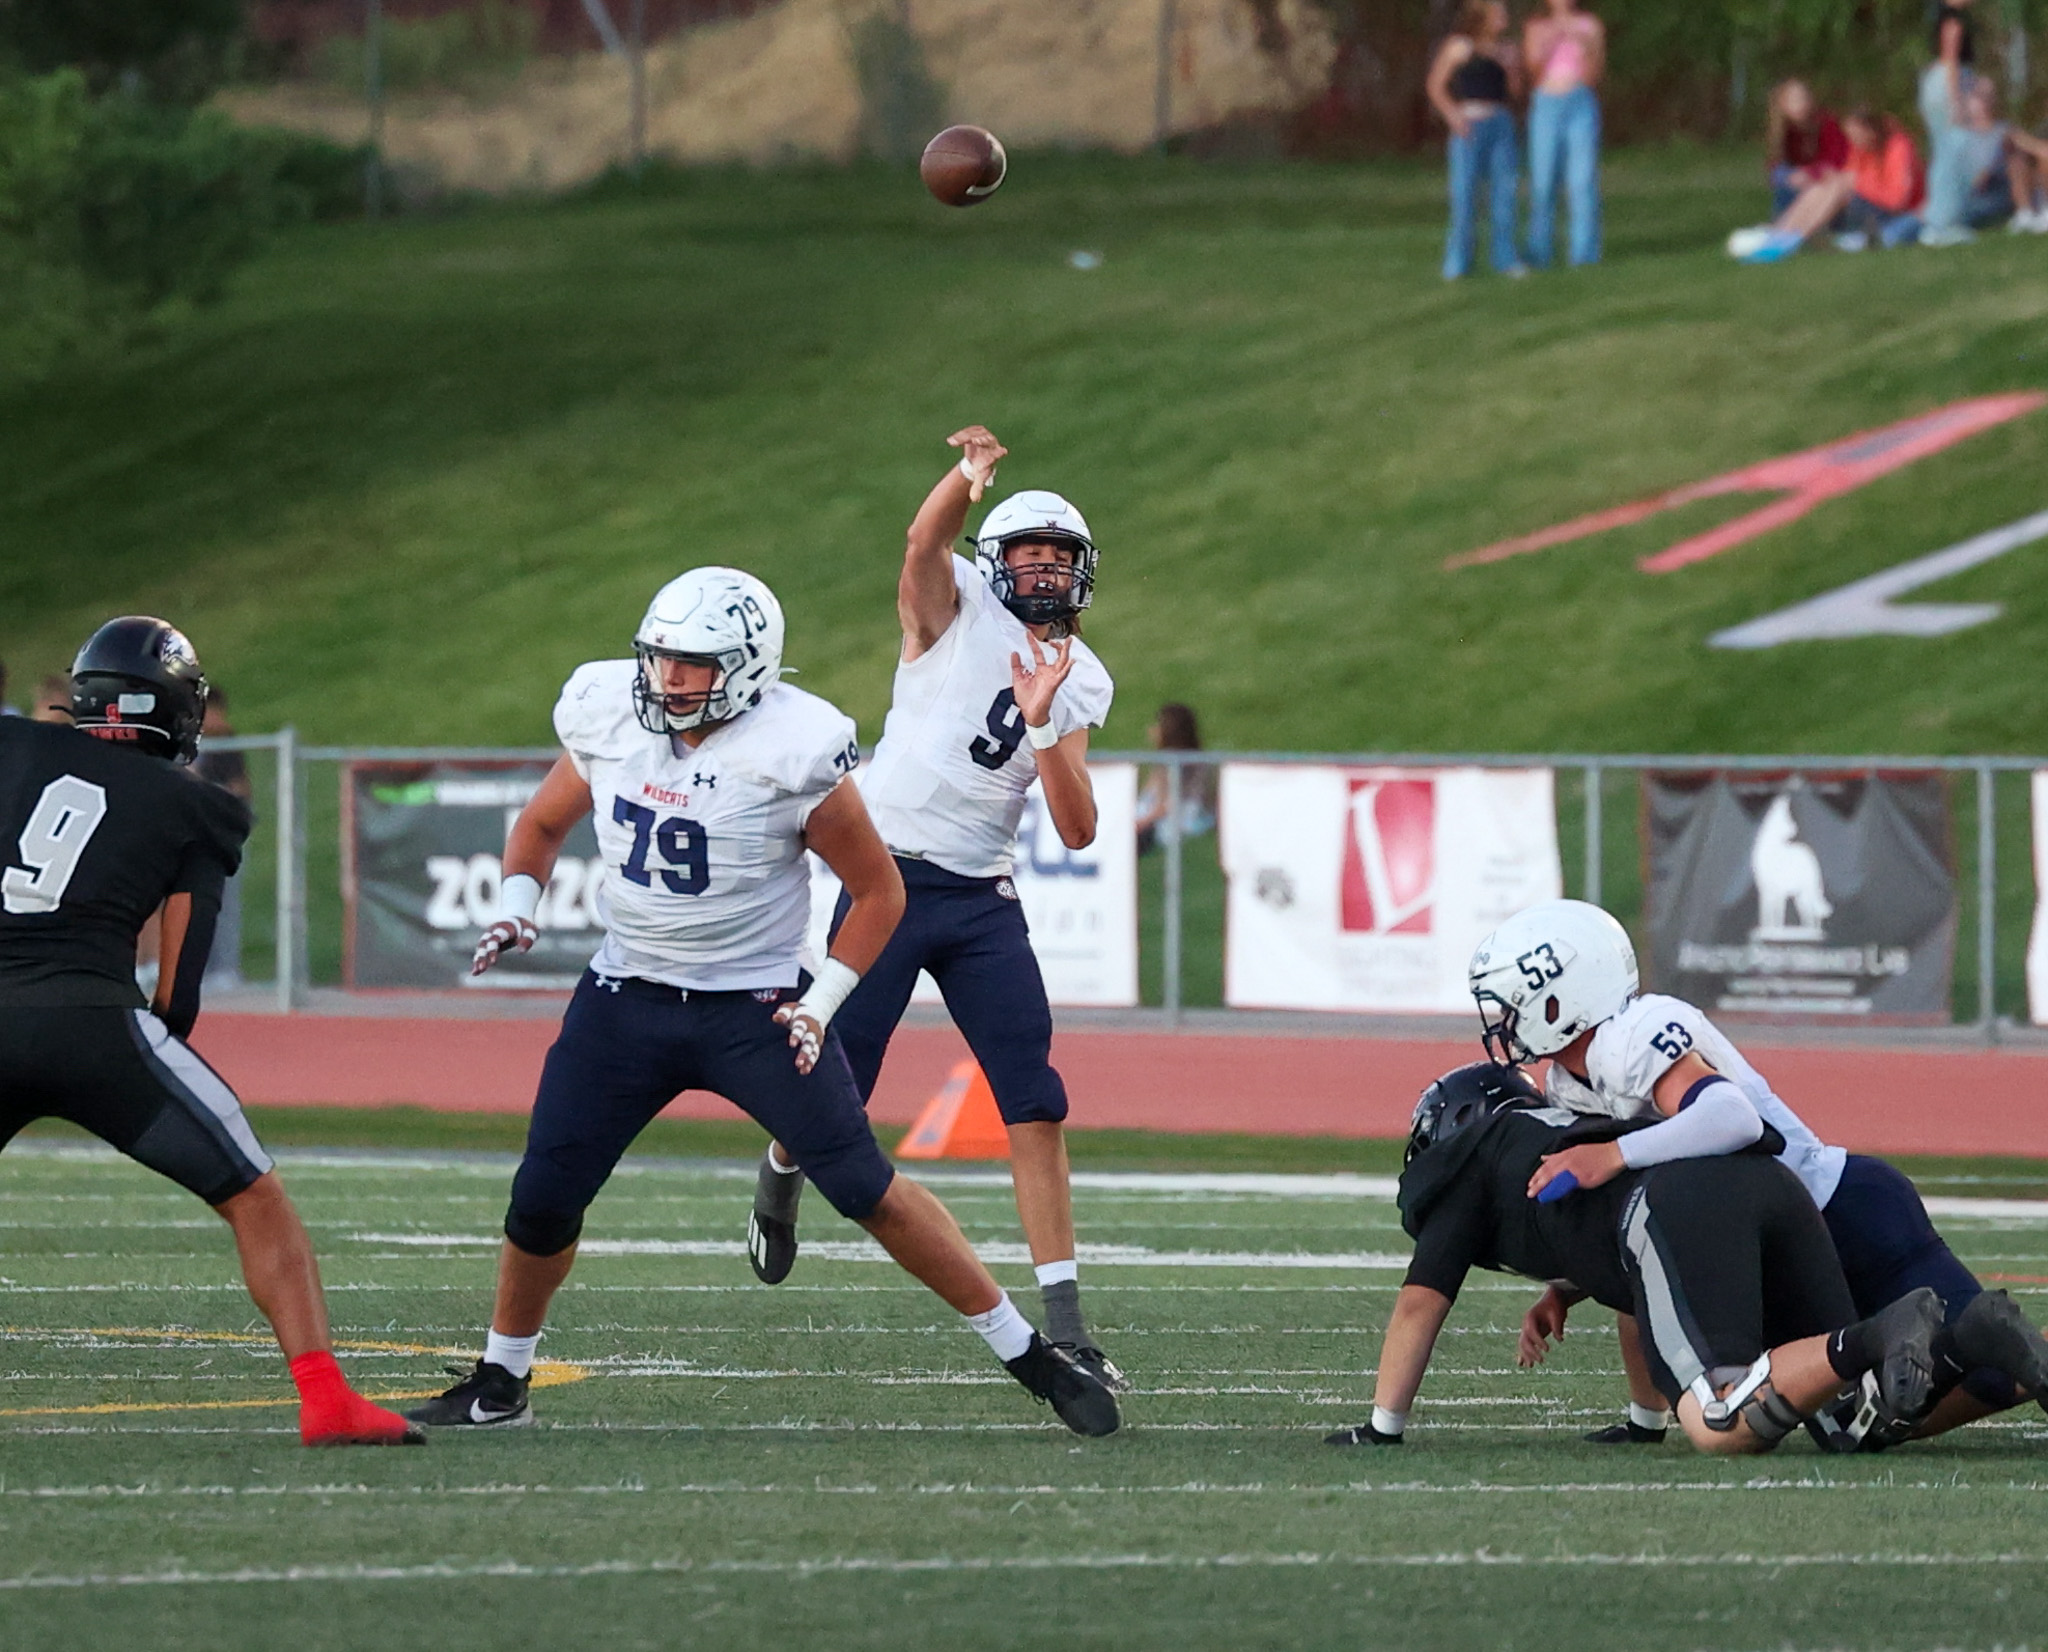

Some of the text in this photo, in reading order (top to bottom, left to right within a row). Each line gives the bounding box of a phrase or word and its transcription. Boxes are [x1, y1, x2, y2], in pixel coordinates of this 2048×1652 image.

[726, 595, 767, 640] 79
[969, 686, 1027, 771] 9
[833, 740, 860, 772] 79
[643, 782, 689, 808] WILDCATS
[1, 775, 107, 914] 9
[612, 794, 711, 897] 79
[1516, 942, 1564, 991] 53
[1650, 1021, 1693, 1061] 53
